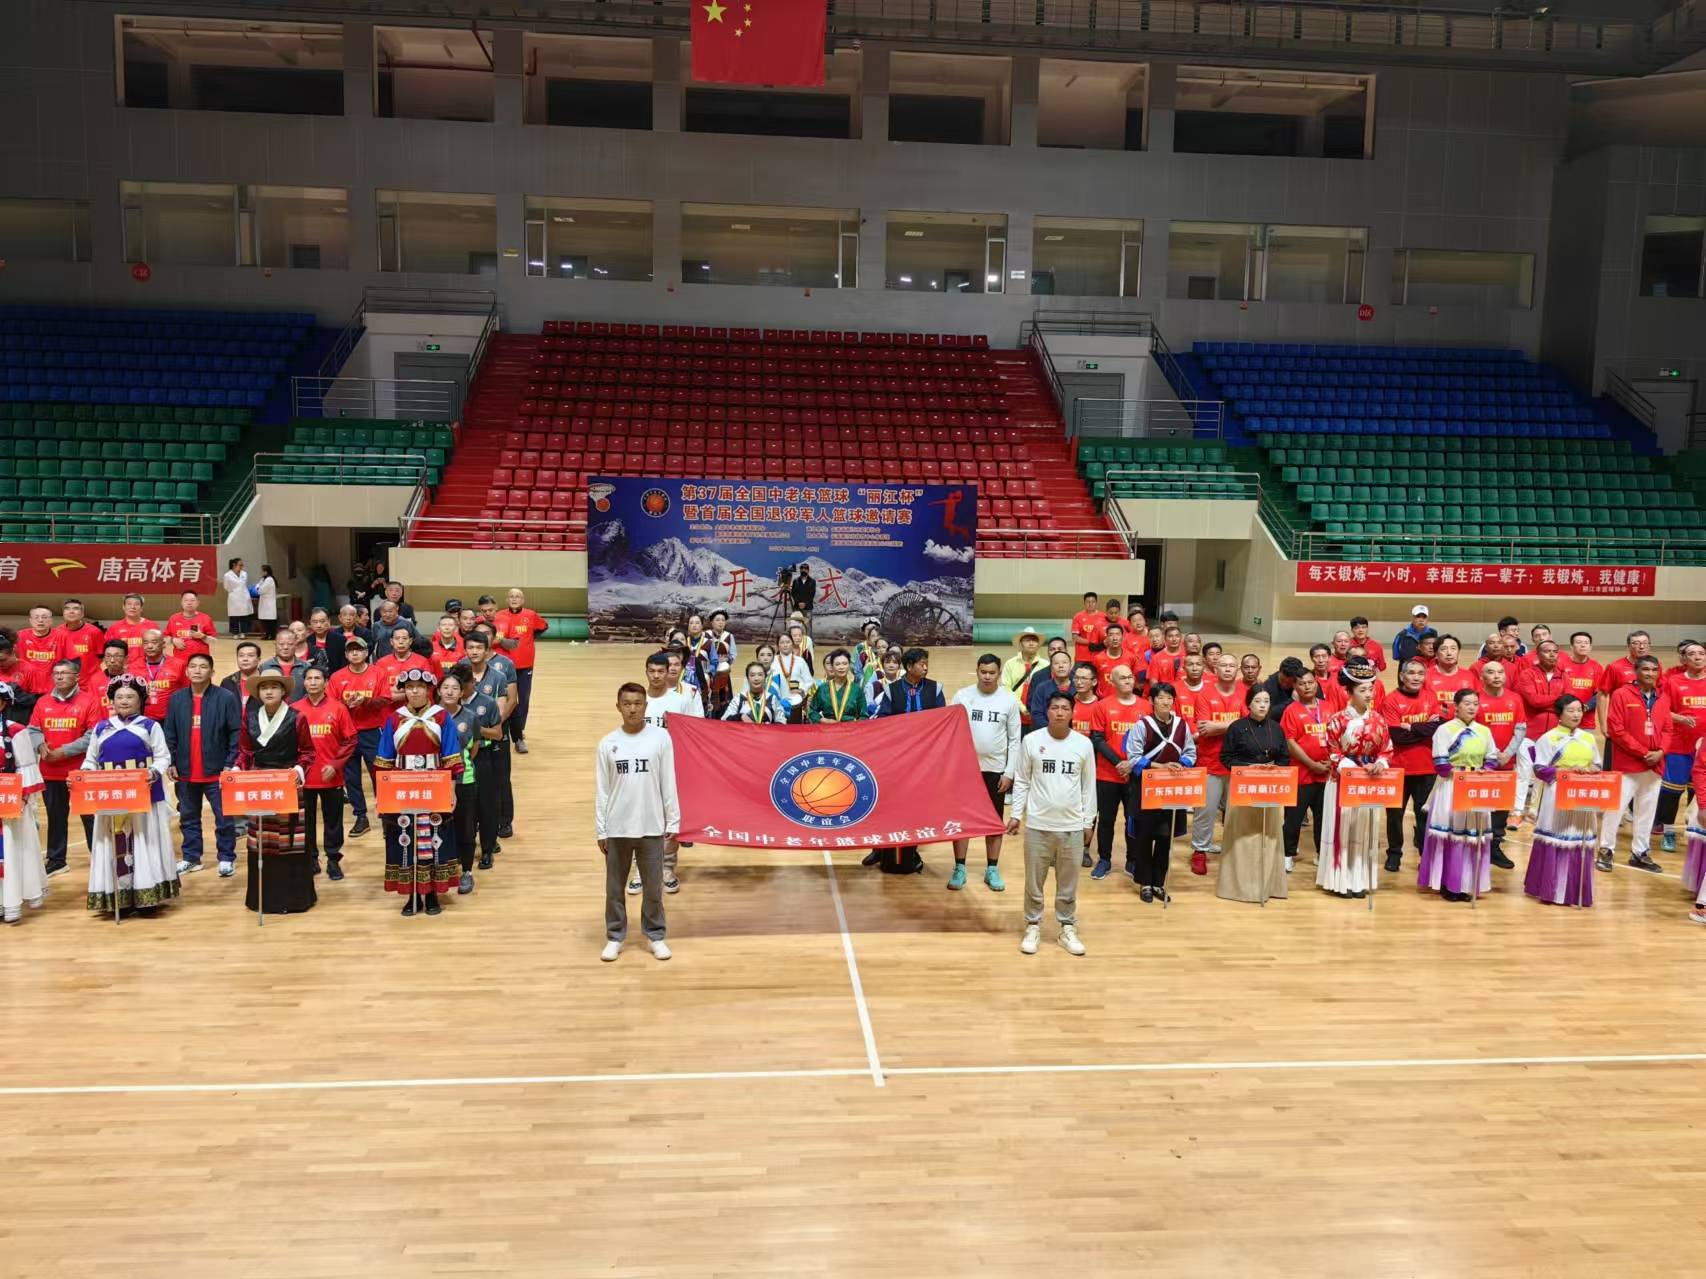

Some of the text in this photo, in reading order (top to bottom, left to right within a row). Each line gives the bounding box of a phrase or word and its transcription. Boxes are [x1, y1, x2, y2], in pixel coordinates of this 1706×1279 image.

[682, 504, 913, 525] 暨首届全国退役军人篮球邀请赛
[97, 556, 204, 583] 唐高体育
[722, 568, 848, 609] 开式
[44, 717, 77, 729] CHINA
[971, 709, 1000, 722] 丽江
[1484, 711, 1514, 722] CHINA
[615, 758, 649, 774] 丽江
[780, 756, 866, 784] 全国中老年篮球
[1042, 759, 1075, 774] 丽江
[801, 815, 850, 826] 联谊会
[702, 820, 963, 848] 全国中老年篮球联谊会
